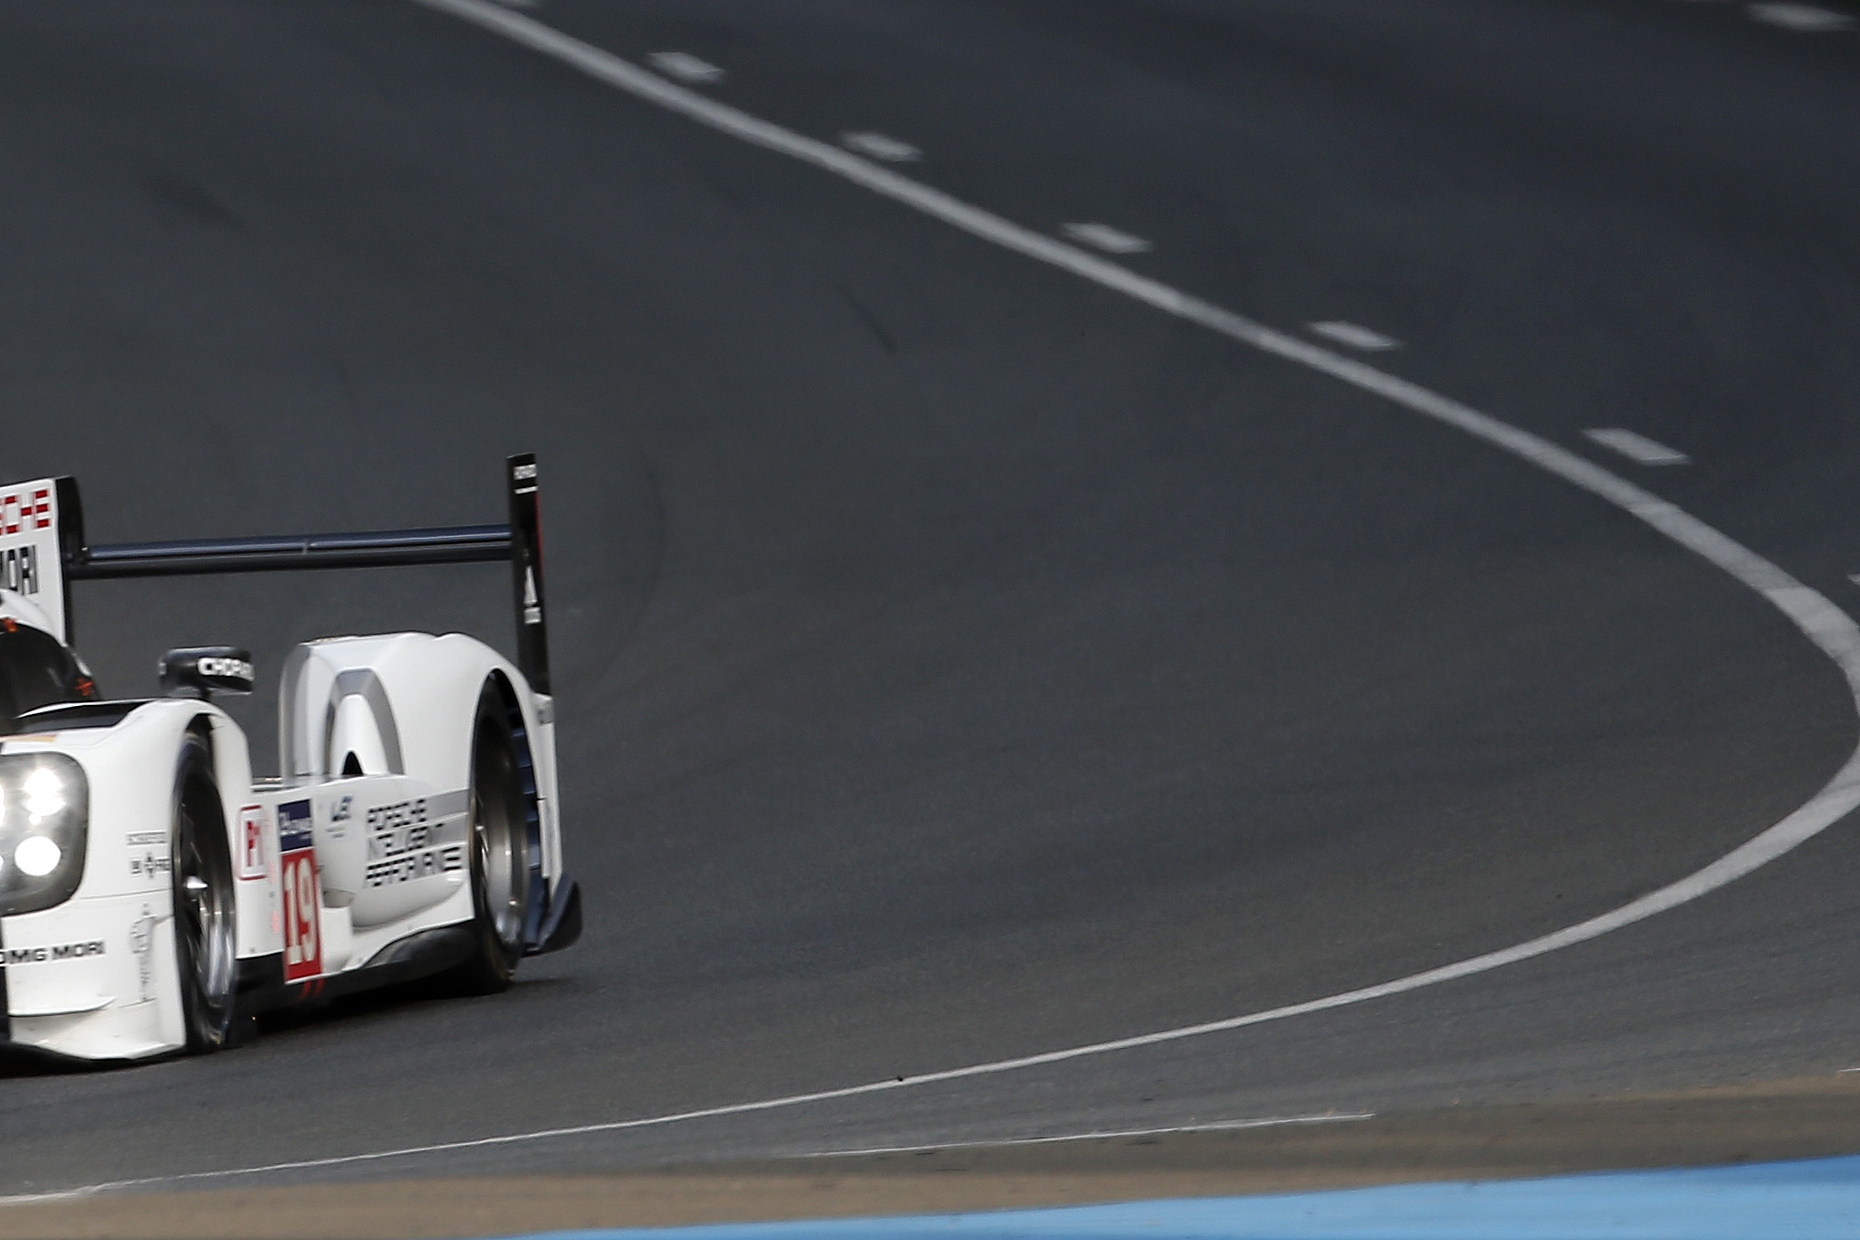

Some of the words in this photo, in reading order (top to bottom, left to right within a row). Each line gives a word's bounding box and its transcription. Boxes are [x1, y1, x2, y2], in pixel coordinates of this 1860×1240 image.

[366, 799, 429, 833] PORSCHE
[363, 846, 463, 888] PERFORMANCE
[283, 857, 317, 965] 19
[51, 940, 106, 962] MORI
